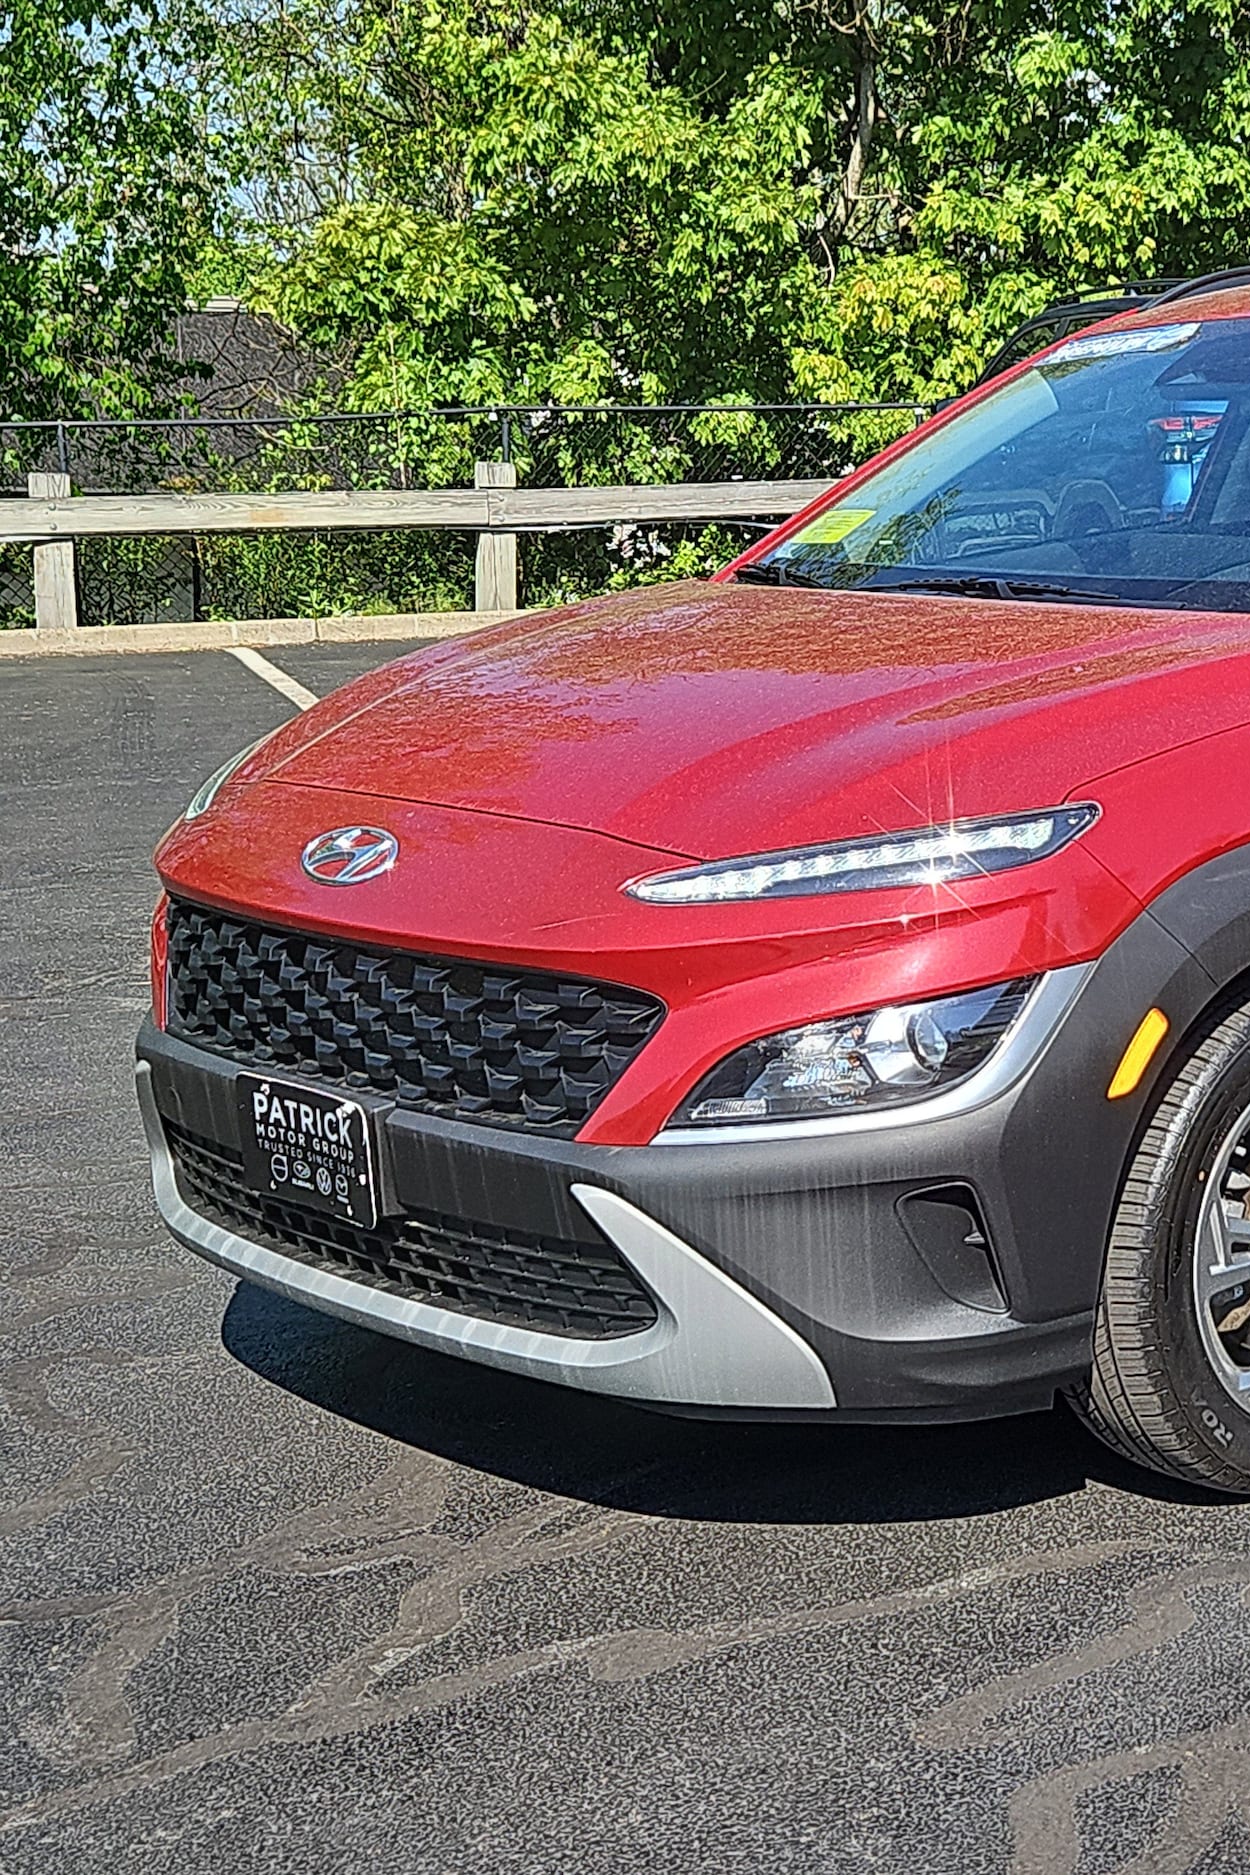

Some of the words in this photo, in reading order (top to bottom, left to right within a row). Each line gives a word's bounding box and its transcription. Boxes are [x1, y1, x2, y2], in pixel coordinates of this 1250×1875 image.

[252, 1091, 353, 1149] PATRICK
[255, 1122, 306, 1147] MOTOR
[312, 1136, 355, 1163] GROUP
[257, 1138, 303, 1159] TRUSTED
[306, 1151, 334, 1169] SINCE
